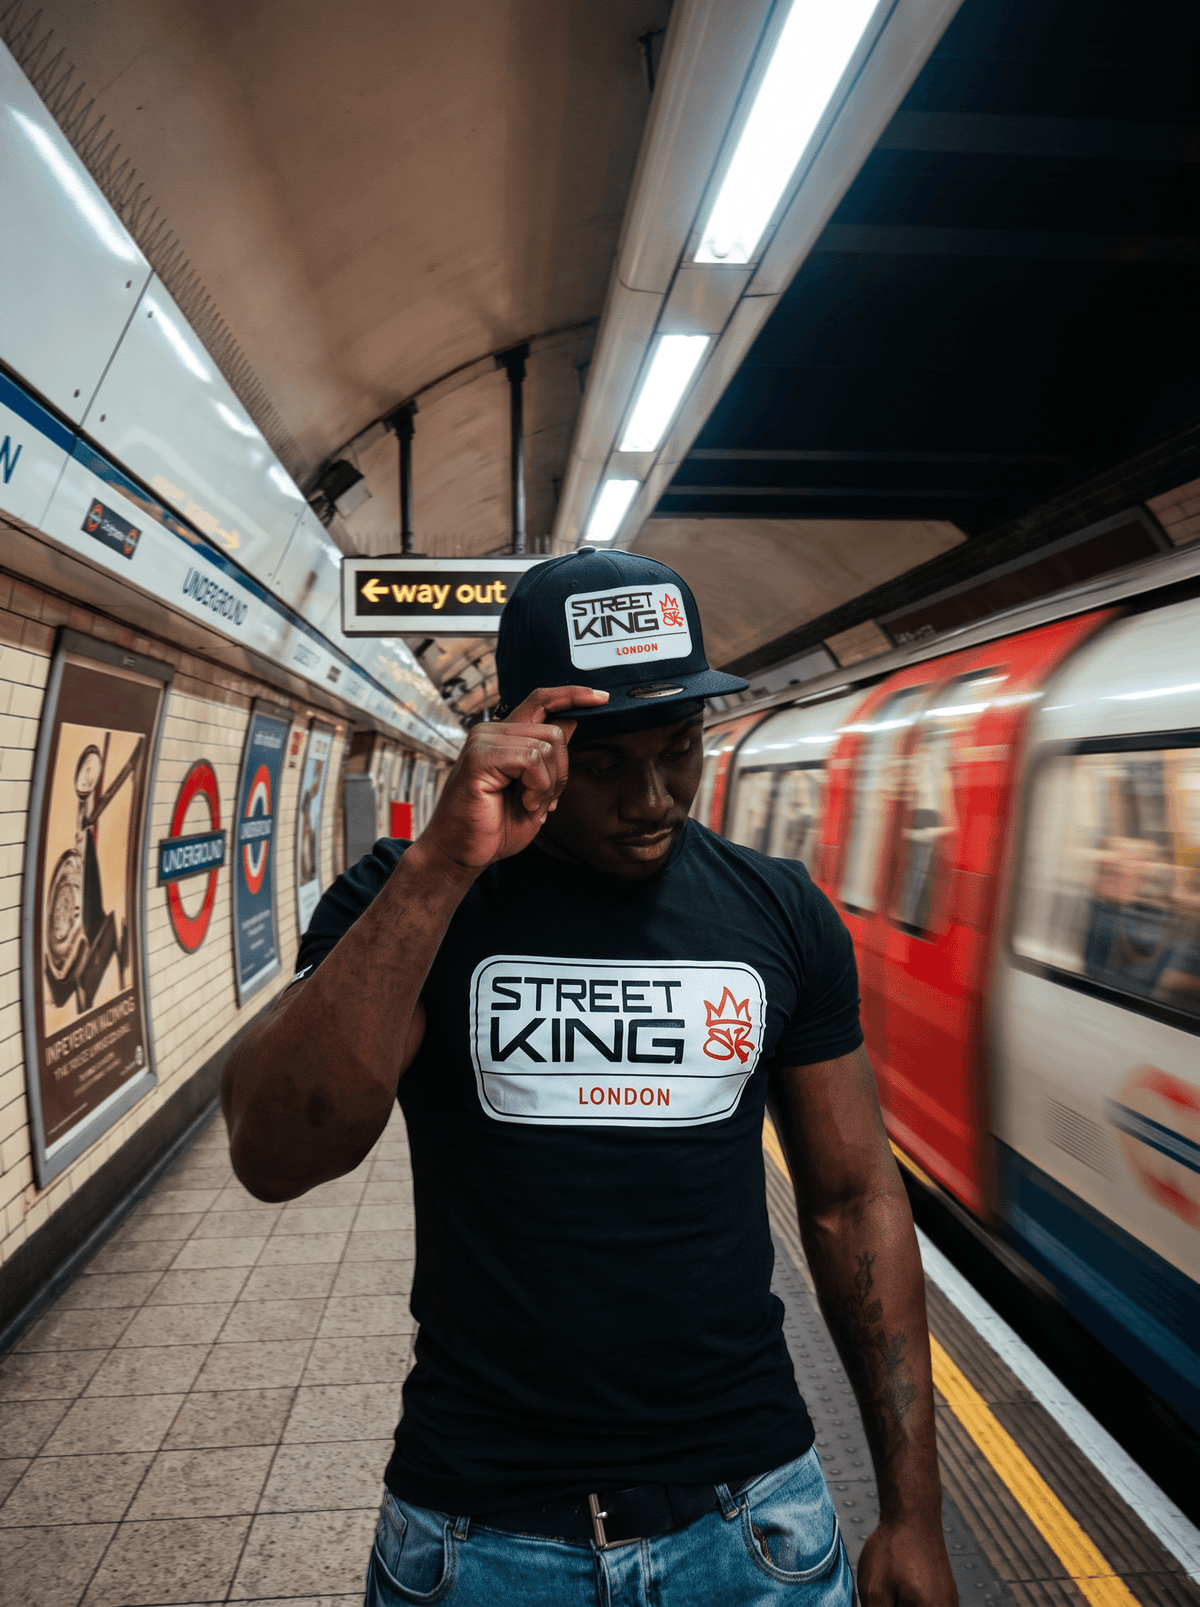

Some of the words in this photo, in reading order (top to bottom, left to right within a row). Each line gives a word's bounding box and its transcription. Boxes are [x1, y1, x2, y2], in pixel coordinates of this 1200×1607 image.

[183, 567, 248, 625] UNDERGROUND
[391, 584, 451, 610] way
[455, 580, 508, 604] out
[571, 592, 653, 617] STREET
[573, 610, 660, 640] KING
[616, 643, 658, 656] LONDON
[163, 839, 223, 873] UNDERGROUND
[490, 976, 682, 1013] STREET
[490, 1017, 686, 1064] KING
[578, 1086, 670, 1106] LONDON
